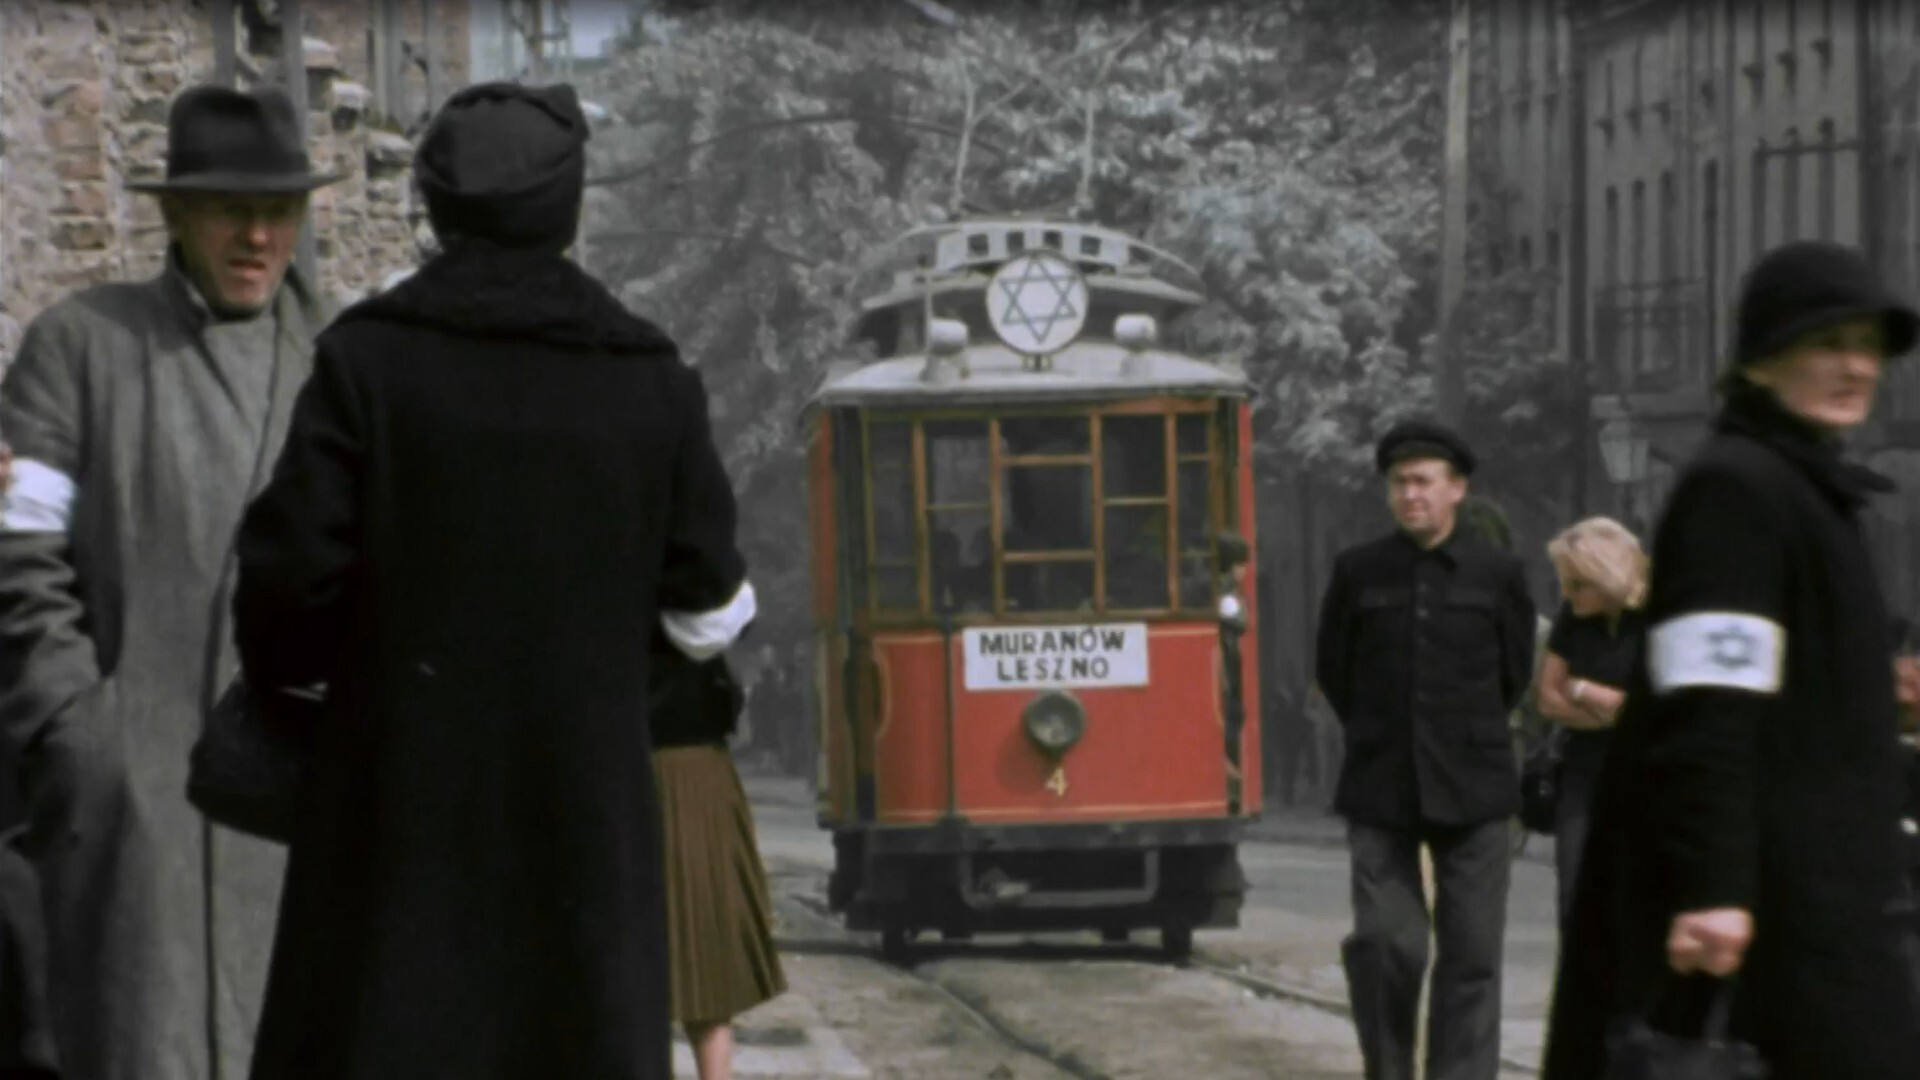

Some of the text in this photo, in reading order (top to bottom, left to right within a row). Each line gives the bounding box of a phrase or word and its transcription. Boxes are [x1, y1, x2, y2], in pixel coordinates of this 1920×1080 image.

[980, 627, 1125, 654] MURANÓW
[997, 657, 1110, 682] LESZNO
[1045, 767, 1067, 797] 4
